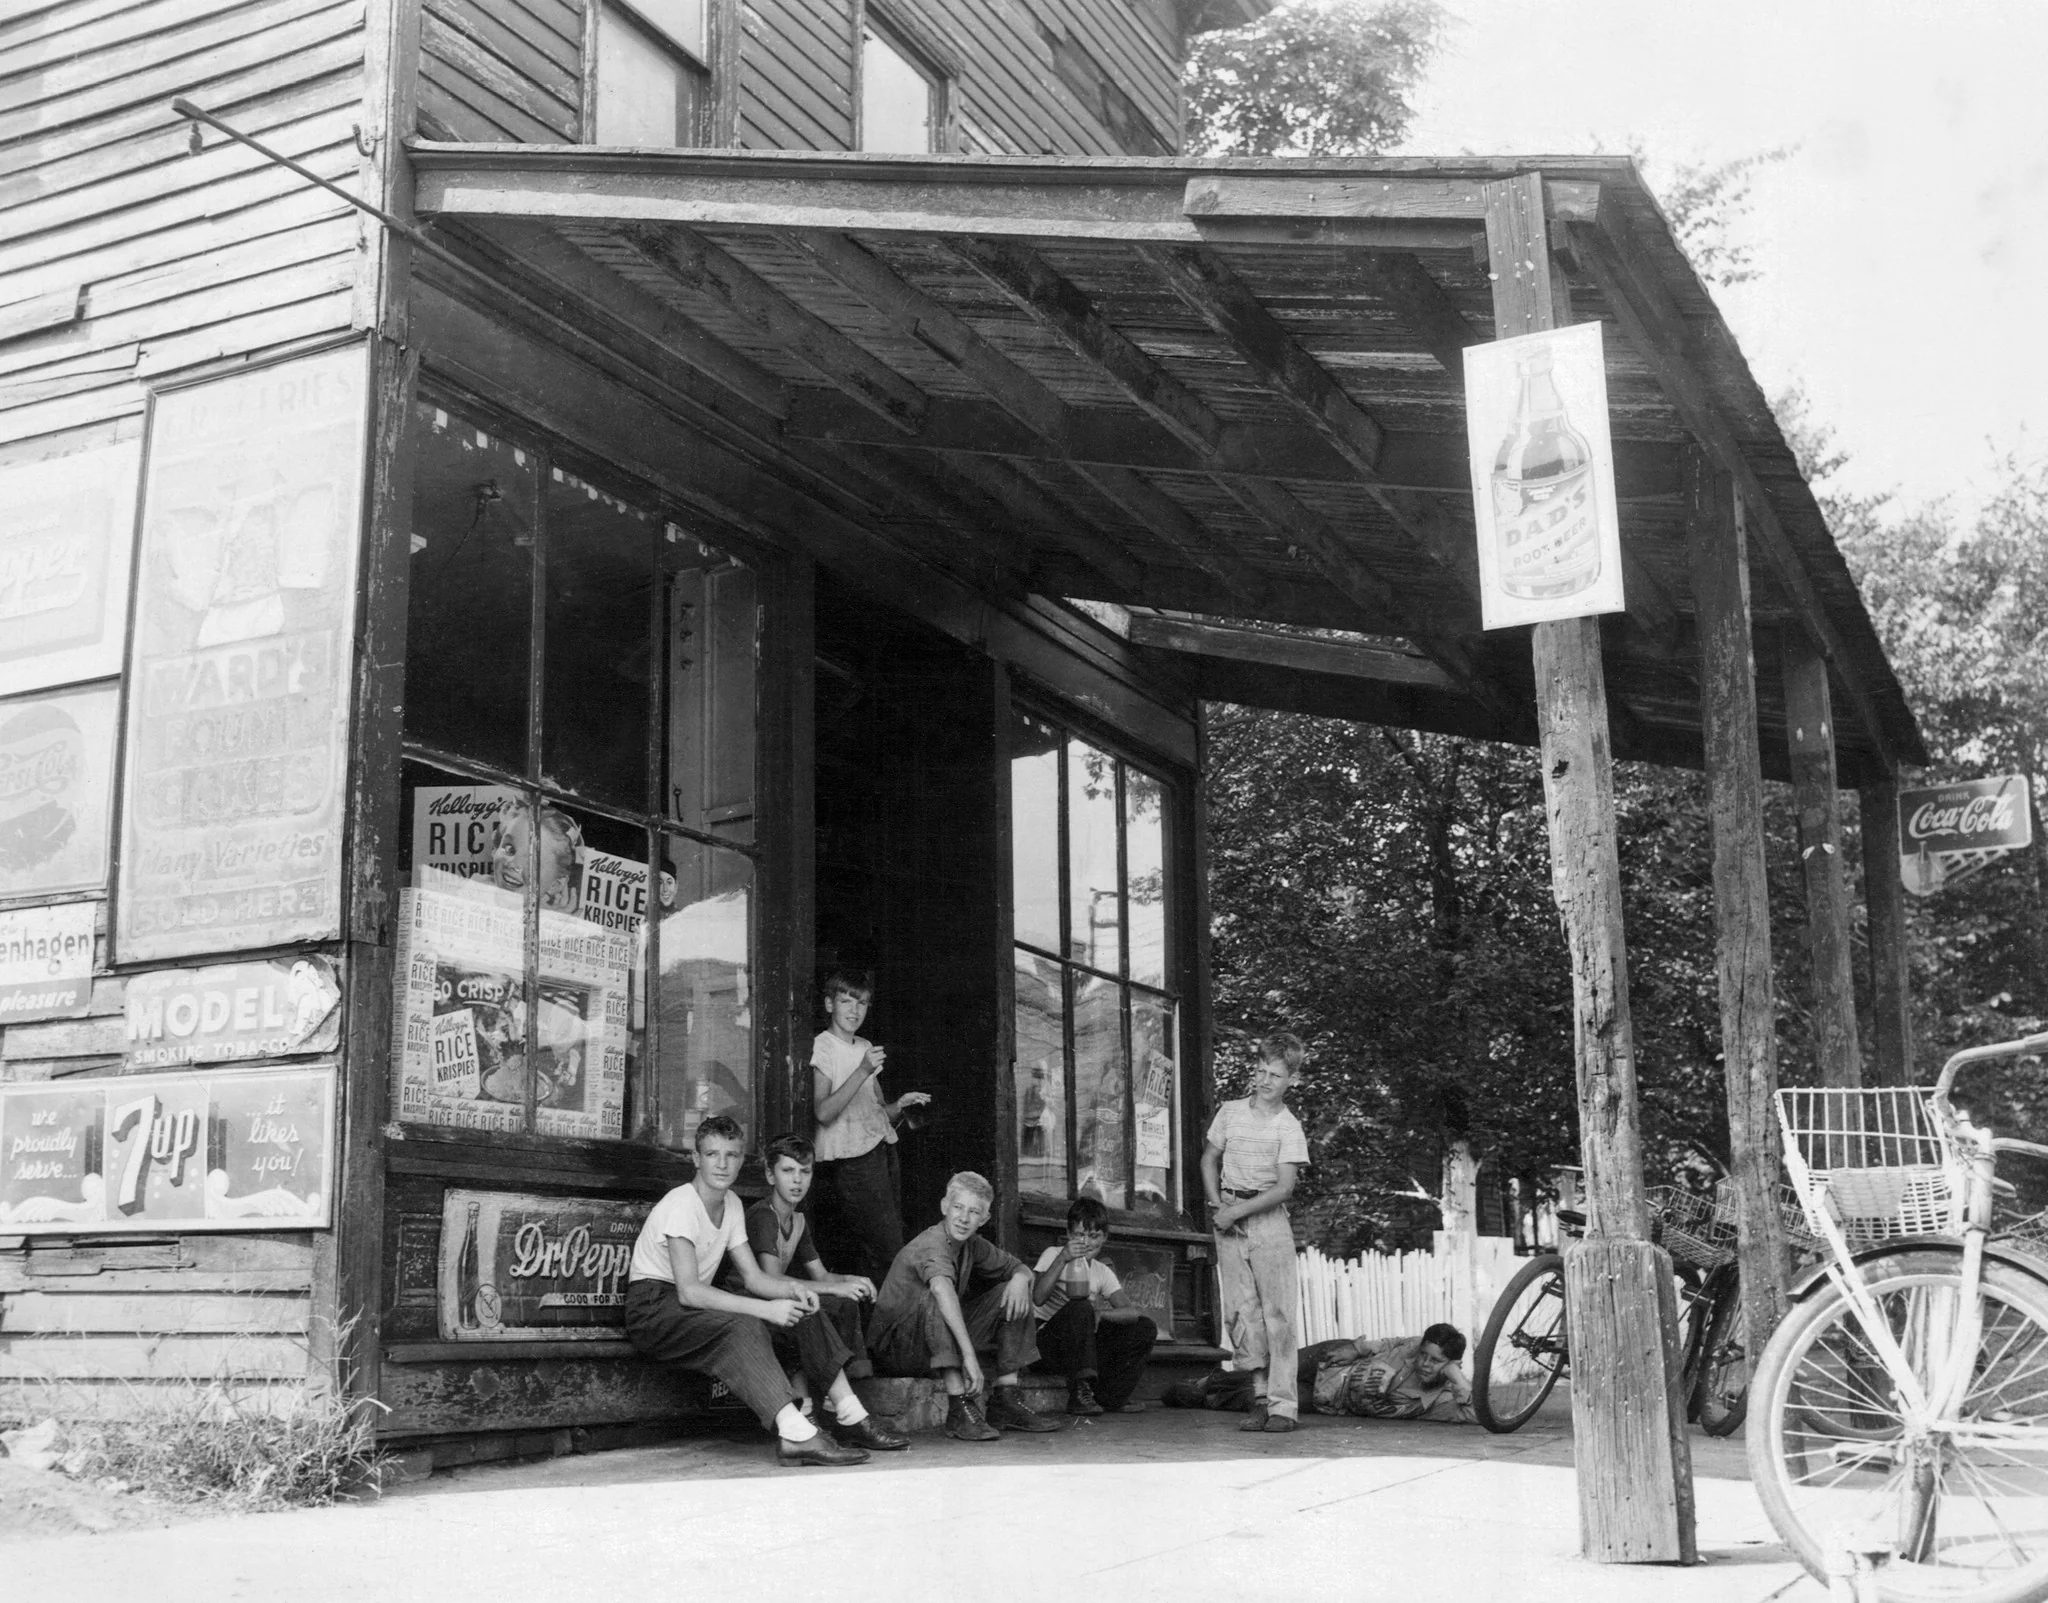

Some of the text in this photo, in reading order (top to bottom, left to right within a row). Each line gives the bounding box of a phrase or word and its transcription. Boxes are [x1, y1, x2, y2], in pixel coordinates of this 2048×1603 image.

[1505, 483, 1587, 548] DAD'S
[1938, 791, 1970, 802] DRINK
[1908, 793, 2018, 838] Coca-Cola
[214, 832, 326, 868] Varieties
[589, 857, 647, 885] Kellogg's
[586, 875, 647, 915] RICE
[135, 887, 321, 933] SOLD HERE
[608, 946, 629, 963] RICE
[411, 964, 435, 982] RICE
[434, 980, 452, 1001] SO
[127, 986, 285, 1041] MODEL
[606, 1000, 626, 1017] RICE
[407, 1024, 431, 1042] RICE
[134, 1038, 291, 1065] SMOKING TOBACCO
[435, 1032, 474, 1064] RICE
[437, 1059, 475, 1082] KRISPIES
[403, 1087, 428, 1104] RICE
[31, 1110, 57, 1127] we
[601, 1110, 622, 1126] RICE
[11, 1126, 77, 1160] proudly
[248, 1120, 300, 1144] likes
[252, 1148, 304, 1181] you!
[509, 1219, 558, 1278] Dr.
[563, 1294, 588, 1304] GOOD
[594, 1294, 611, 1304] FOR
